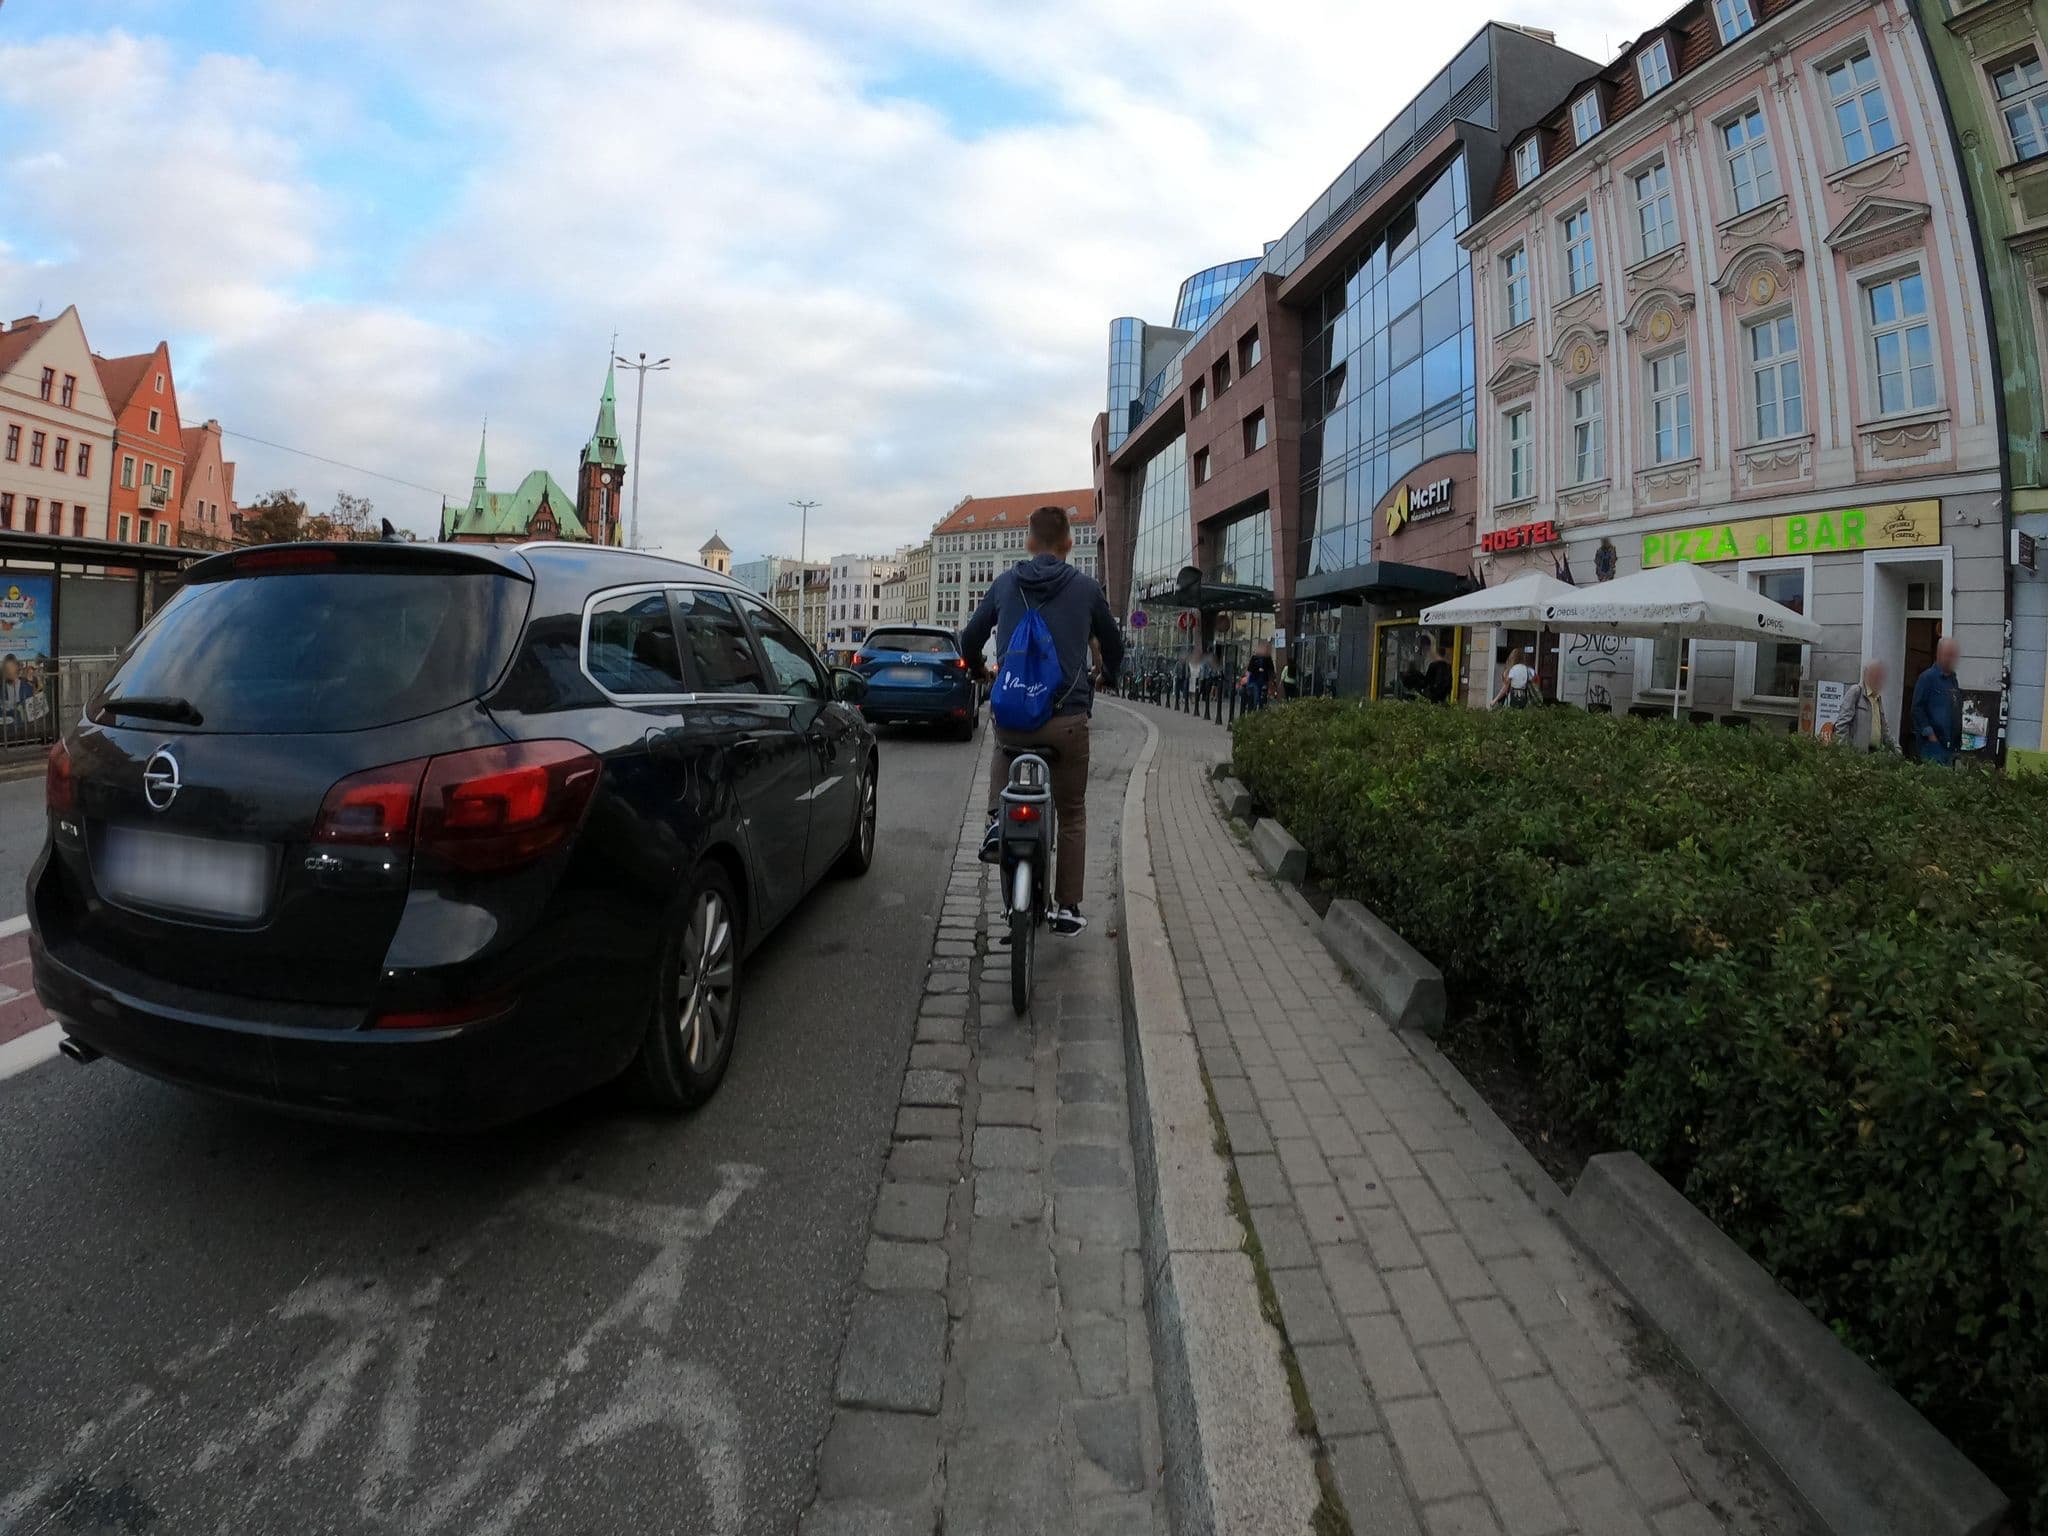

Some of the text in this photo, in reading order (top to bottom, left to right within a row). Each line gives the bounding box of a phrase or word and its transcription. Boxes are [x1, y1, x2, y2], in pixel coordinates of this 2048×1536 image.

[1481, 521, 1558, 553] HOSTEL
[1643, 526, 1740, 566] PIZZA
[1786, 510, 1867, 551] BAR
[1556, 607, 1578, 616] pepsi
